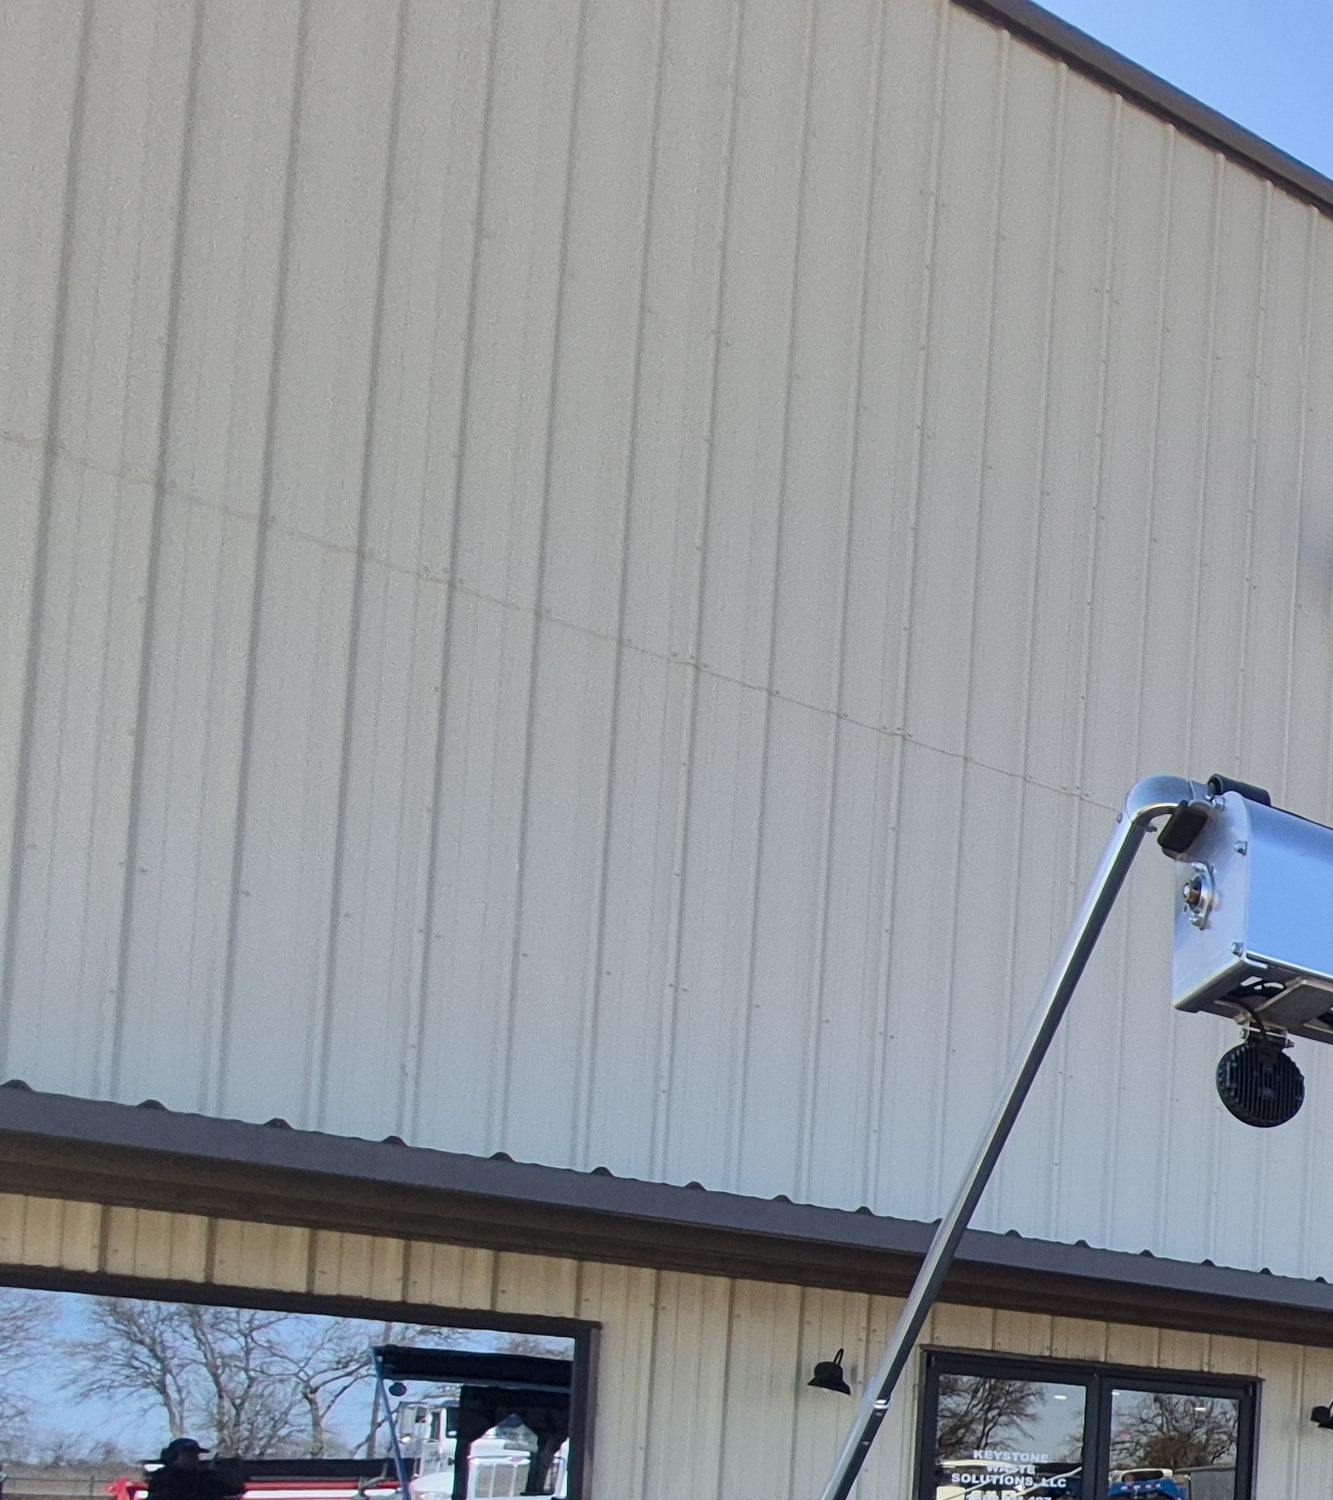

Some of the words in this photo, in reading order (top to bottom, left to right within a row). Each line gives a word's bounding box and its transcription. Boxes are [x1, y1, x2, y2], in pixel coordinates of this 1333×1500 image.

[973, 1450, 1049, 1463] KEYSTONE
[987, 1464, 1035, 1475] WASTE
[951, 1473, 1037, 1487] SOLUTIONS,
[1041, 1478, 1067, 1488] LLC
